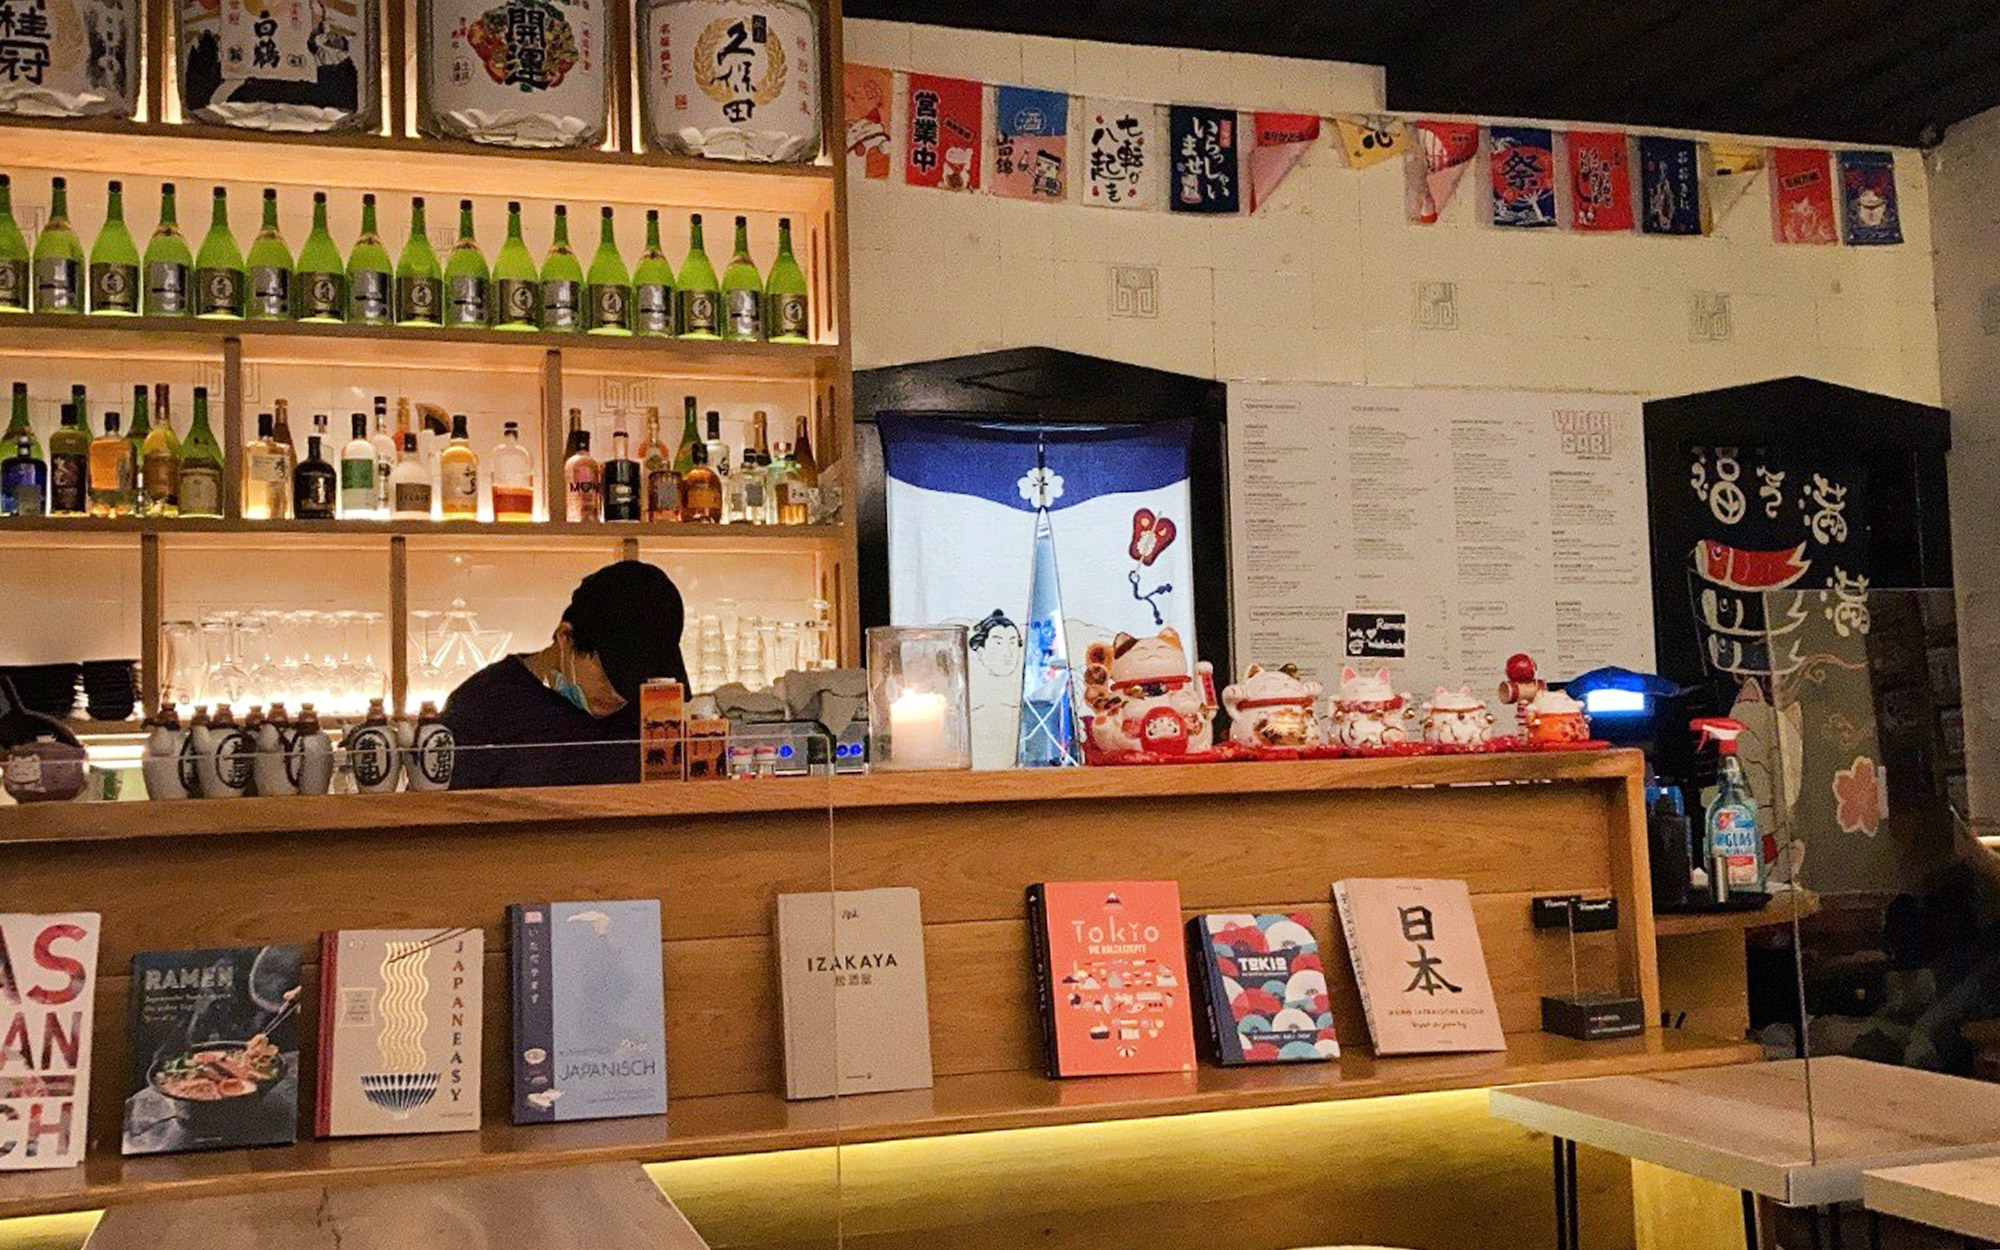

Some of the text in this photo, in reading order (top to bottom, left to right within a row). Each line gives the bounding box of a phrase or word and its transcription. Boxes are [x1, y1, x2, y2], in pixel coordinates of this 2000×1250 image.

[0, 0, 51, 86] 桂冠
[253, 10, 281, 69] 白鶴
[707, 20, 757, 124] 久保田
[913, 90, 941, 174] 営業中
[1502, 150, 1543, 191] 祭
[144, 965, 234, 991] RAMEN
[806, 953, 898, 973] IZAKAYA
[1237, 956, 1288, 973] TOKIO
[1396, 905, 1464, 997] 日本
[449, 940, 465, 1102] JAPANEASY
[558, 1059, 656, 1081] JAPANISCH
